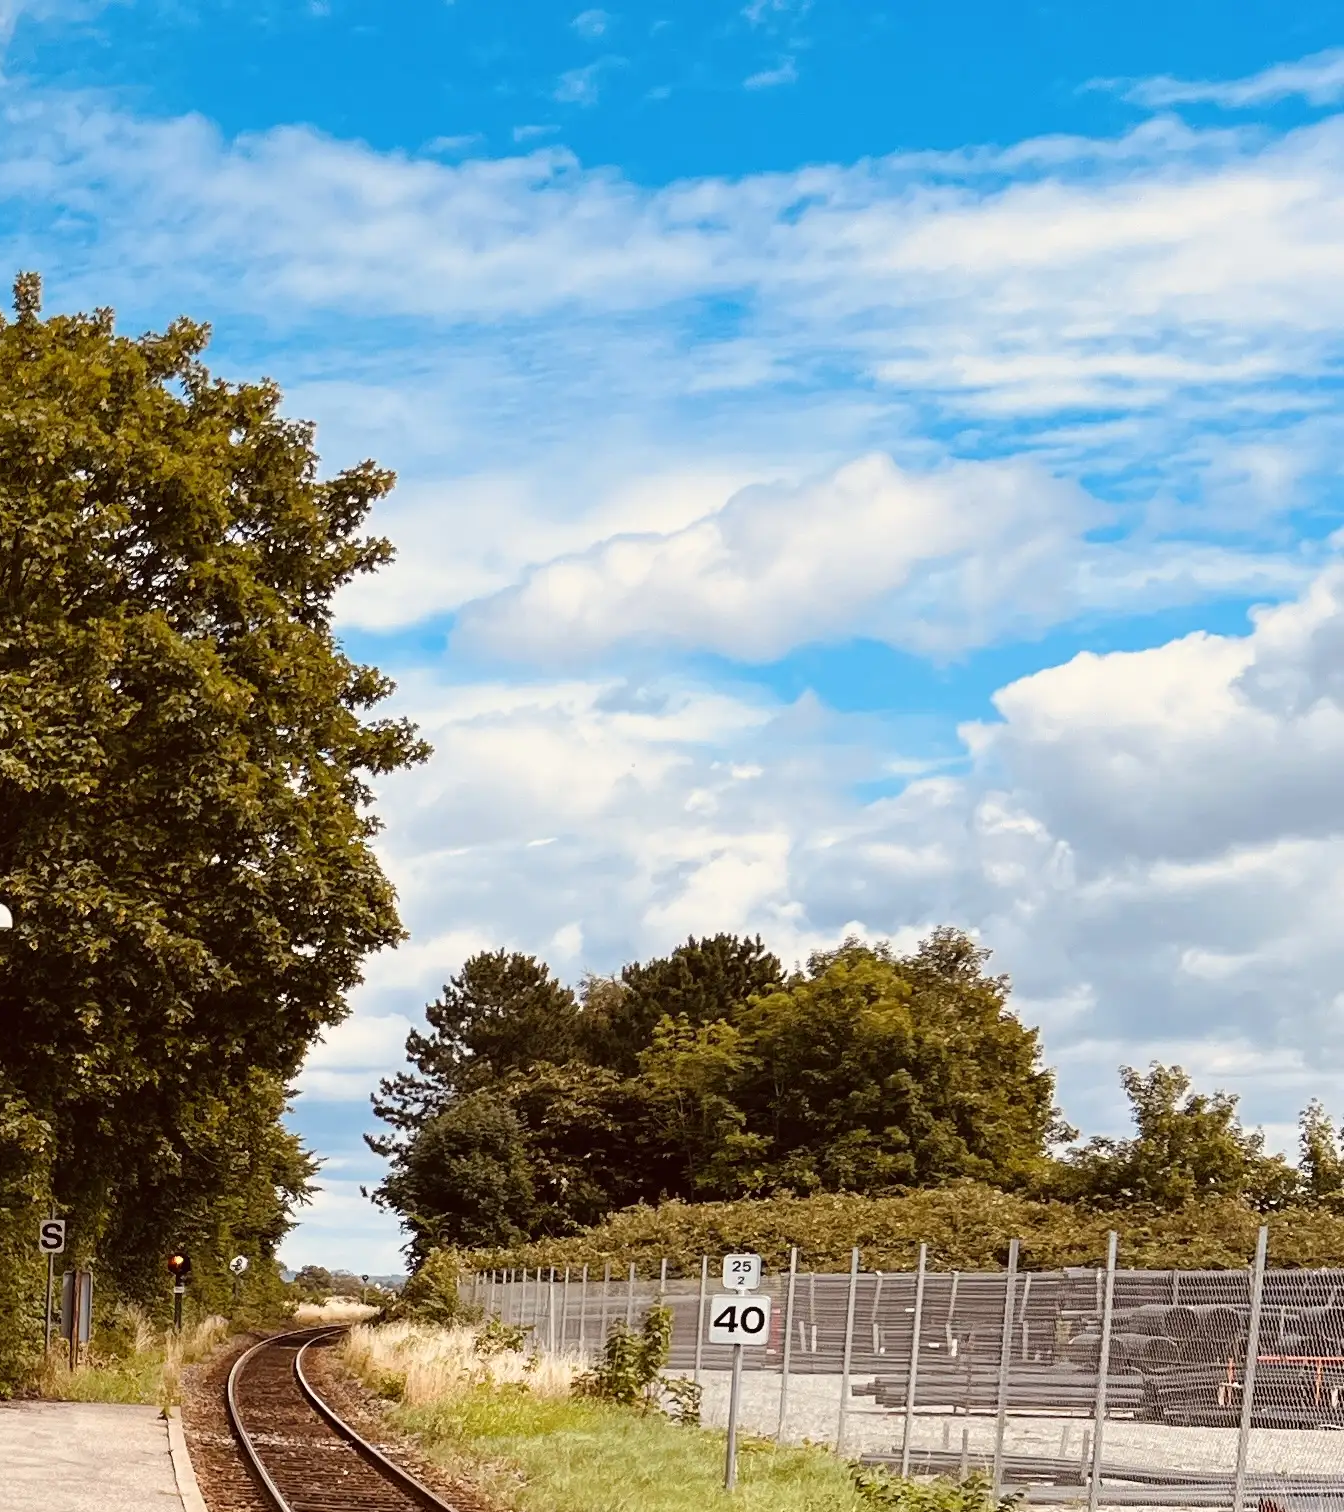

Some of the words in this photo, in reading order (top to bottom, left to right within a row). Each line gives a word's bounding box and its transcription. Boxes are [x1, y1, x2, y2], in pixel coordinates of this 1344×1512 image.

[41, 1222, 63, 1250] S
[732, 1260, 752, 1273] 25
[737, 1276, 745, 1285] 2
[713, 1305, 765, 1334] 40
